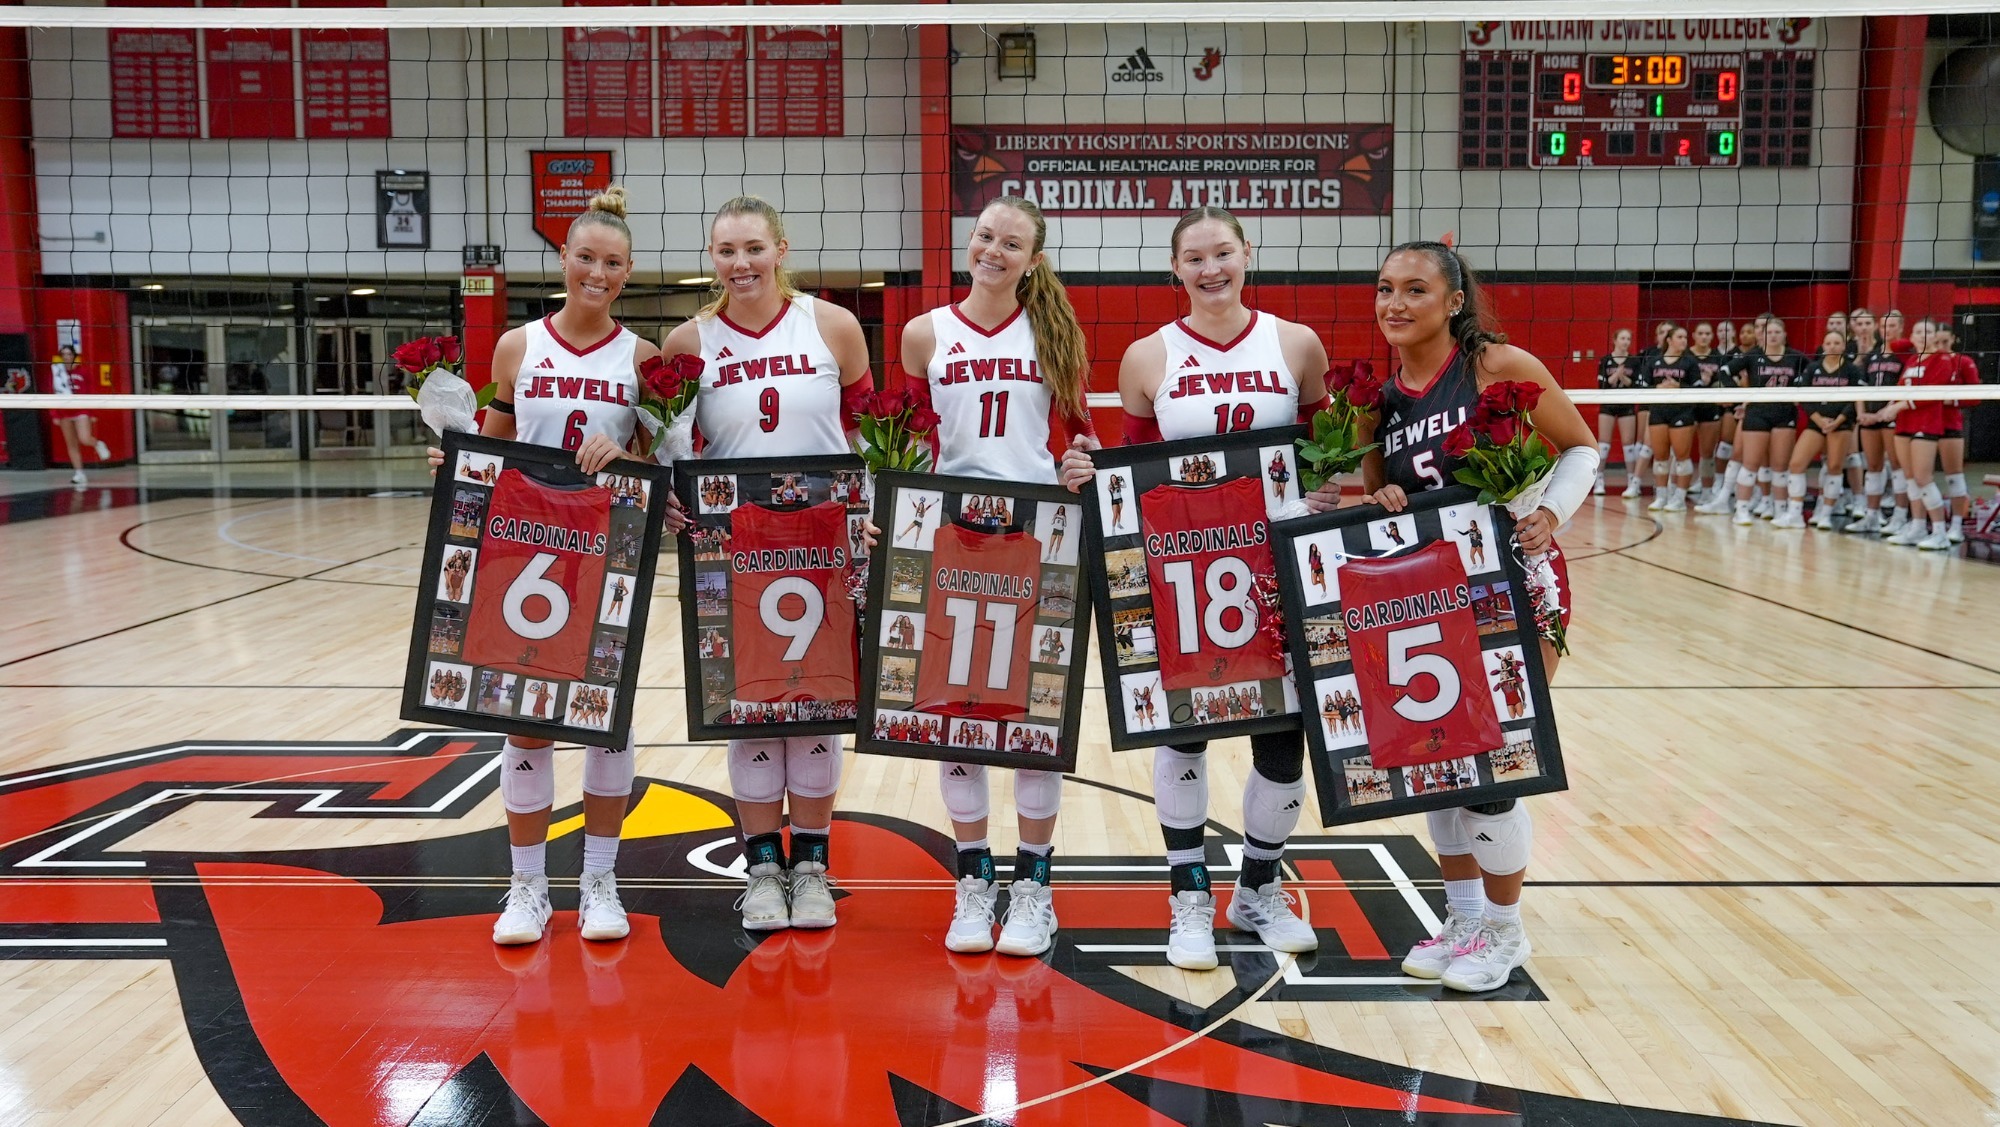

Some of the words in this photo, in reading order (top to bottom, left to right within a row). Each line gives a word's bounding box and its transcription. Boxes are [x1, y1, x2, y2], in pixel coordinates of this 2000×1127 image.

[1510, 20, 1594, 40] WILLIAM
[1601, 19, 1677, 40] JEWELL
[1684, 19, 1771, 40] COLLEGE
[1543, 55, 1579, 68] HOME
[1611, 56, 1682, 84] 3:00
[1690, 54, 1741, 68] VISITOR
[1111, 70, 1164, 82] adidas
[1563, 73, 1581, 101] 0
[1718, 72, 1736, 101] 0
[1554, 105, 1585, 116] BONUS
[1655, 94, 1663, 117] 1
[994, 135, 1079, 150] LIBERTY
[1079, 135, 1171, 150] HOSPITAL
[1175, 134, 1248, 150] SPORTS
[1251, 134, 1349, 150] MEDICINE
[1550, 133, 1565, 156] 0
[1581, 139, 1592, 156] 2
[1679, 139, 1690, 156] 2
[1719, 132, 1735, 156] 0
[1028, 160, 1096, 172] OFFICIAL
[1101, 159, 1200, 172] HEALTHCARE
[1203, 159, 1281, 171] PROVIDER
[1284, 159, 1316, 171] FOR
[541, 189, 604, 198] CONFERENC
[561, 179, 584, 187] 2024
[1001, 179, 1155, 210] CARDINAL
[1168, 178, 1341, 209] ATHLETICS
[544, 199, 590, 208] CHAMPIO
[712, 354, 817, 388] JEWELL
[939, 358, 1044, 386] JEWELL
[1169, 370, 1288, 400] JEWELL
[524, 376, 630, 407] JEWELL
[759, 387, 780, 433] 9
[979, 391, 1009, 438] 11
[562, 410, 588, 451] 6
[1412, 450, 1444, 491] 5
[489, 515, 607, 556] CARDINALS
[1147, 520, 1267, 557] CARDINALS
[733, 546, 846, 573] CARDINALS
[502, 551, 571, 640] 6
[936, 567, 1033, 599] CARDINALS
[759, 575, 825, 662] 9
[1163, 556, 1260, 655] 18
[1346, 583, 1471, 632] CARDINALS
[944, 597, 1019, 690] 11
[1387, 622, 1461, 722] 5
